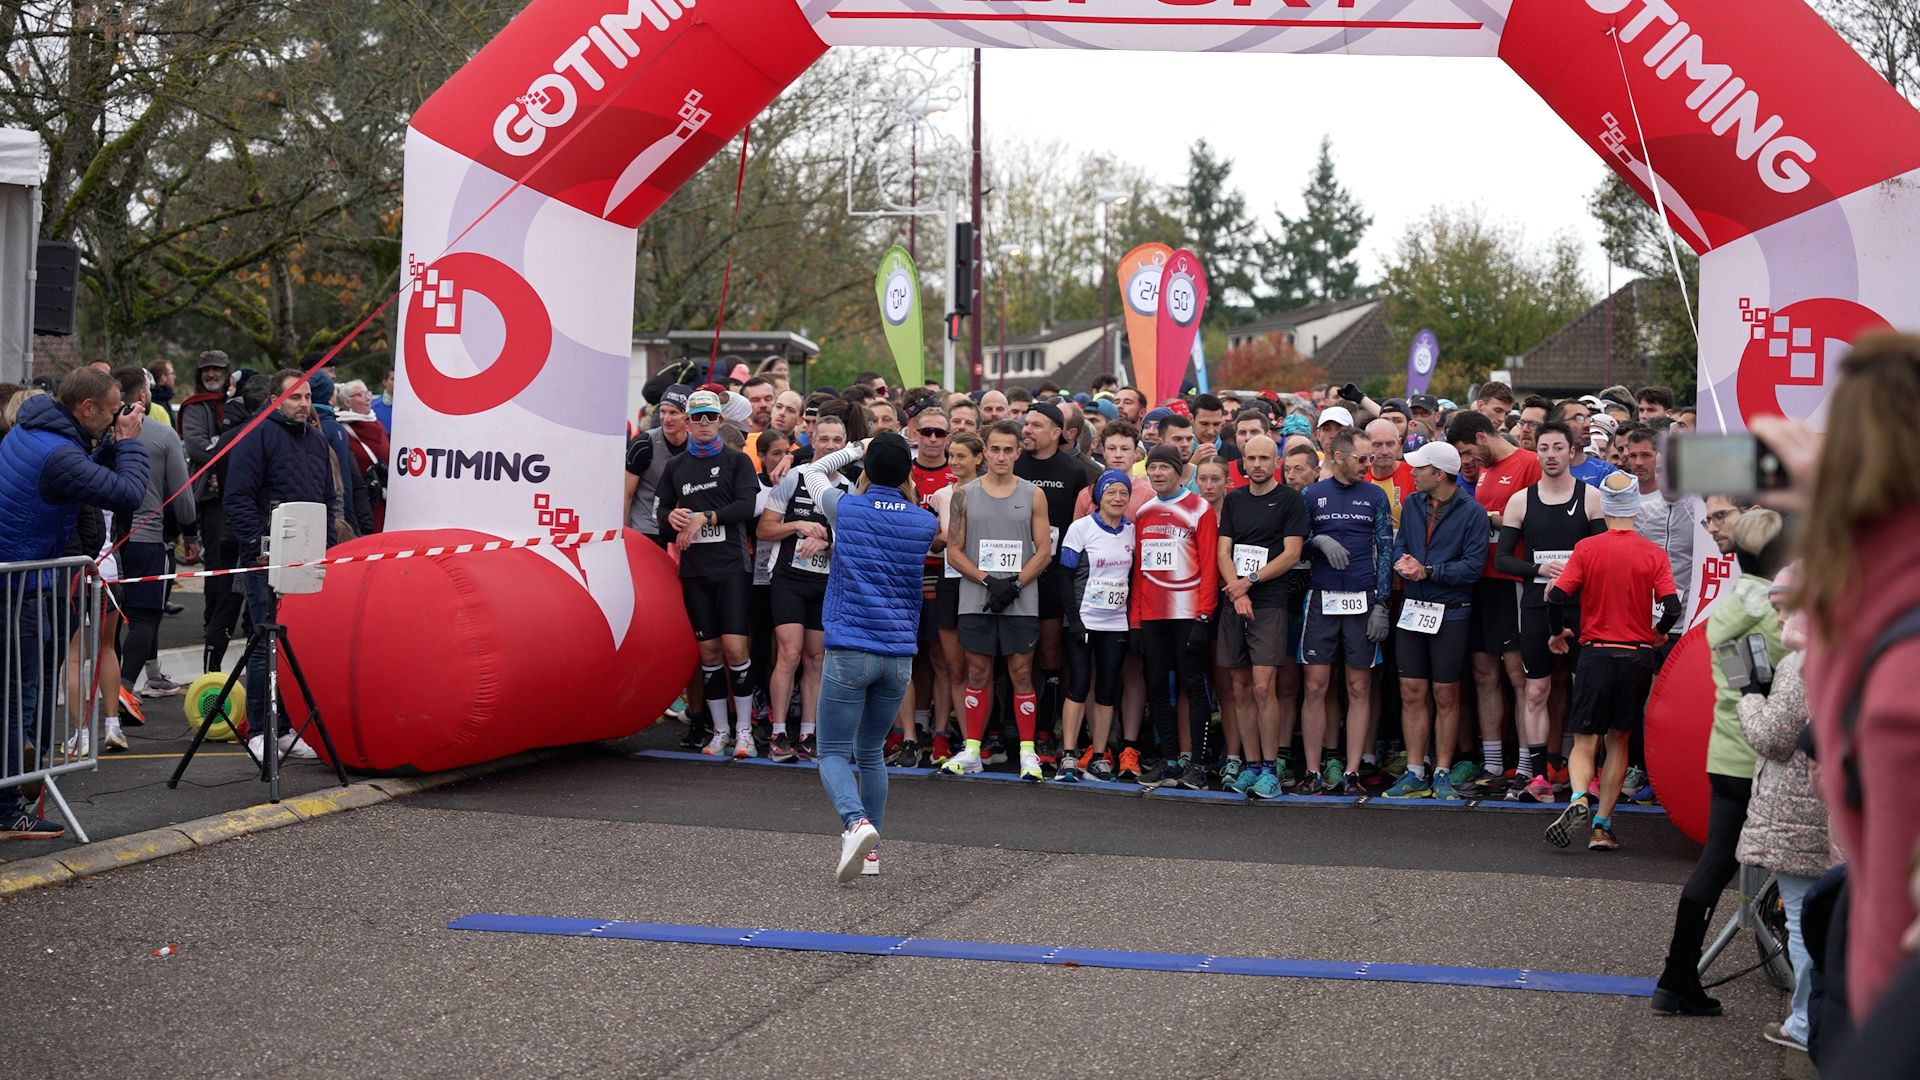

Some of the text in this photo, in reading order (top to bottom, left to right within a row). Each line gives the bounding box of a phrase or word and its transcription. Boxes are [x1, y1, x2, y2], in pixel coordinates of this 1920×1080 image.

[1173, 289, 1191, 311] 50'
[396, 447, 550, 484] GOTIMING
[874, 500, 906, 511] STAFF
[1331, 512, 1350, 520] Club
[701, 525, 721, 538] 650
[1000, 554, 1017, 567] 317
[1156, 552, 1172, 565] 841
[1244, 558, 1260, 571] 531
[1108, 591, 1125, 605] 825
[1341, 599, 1362, 610] 903
[1417, 613, 1437, 629] 759
